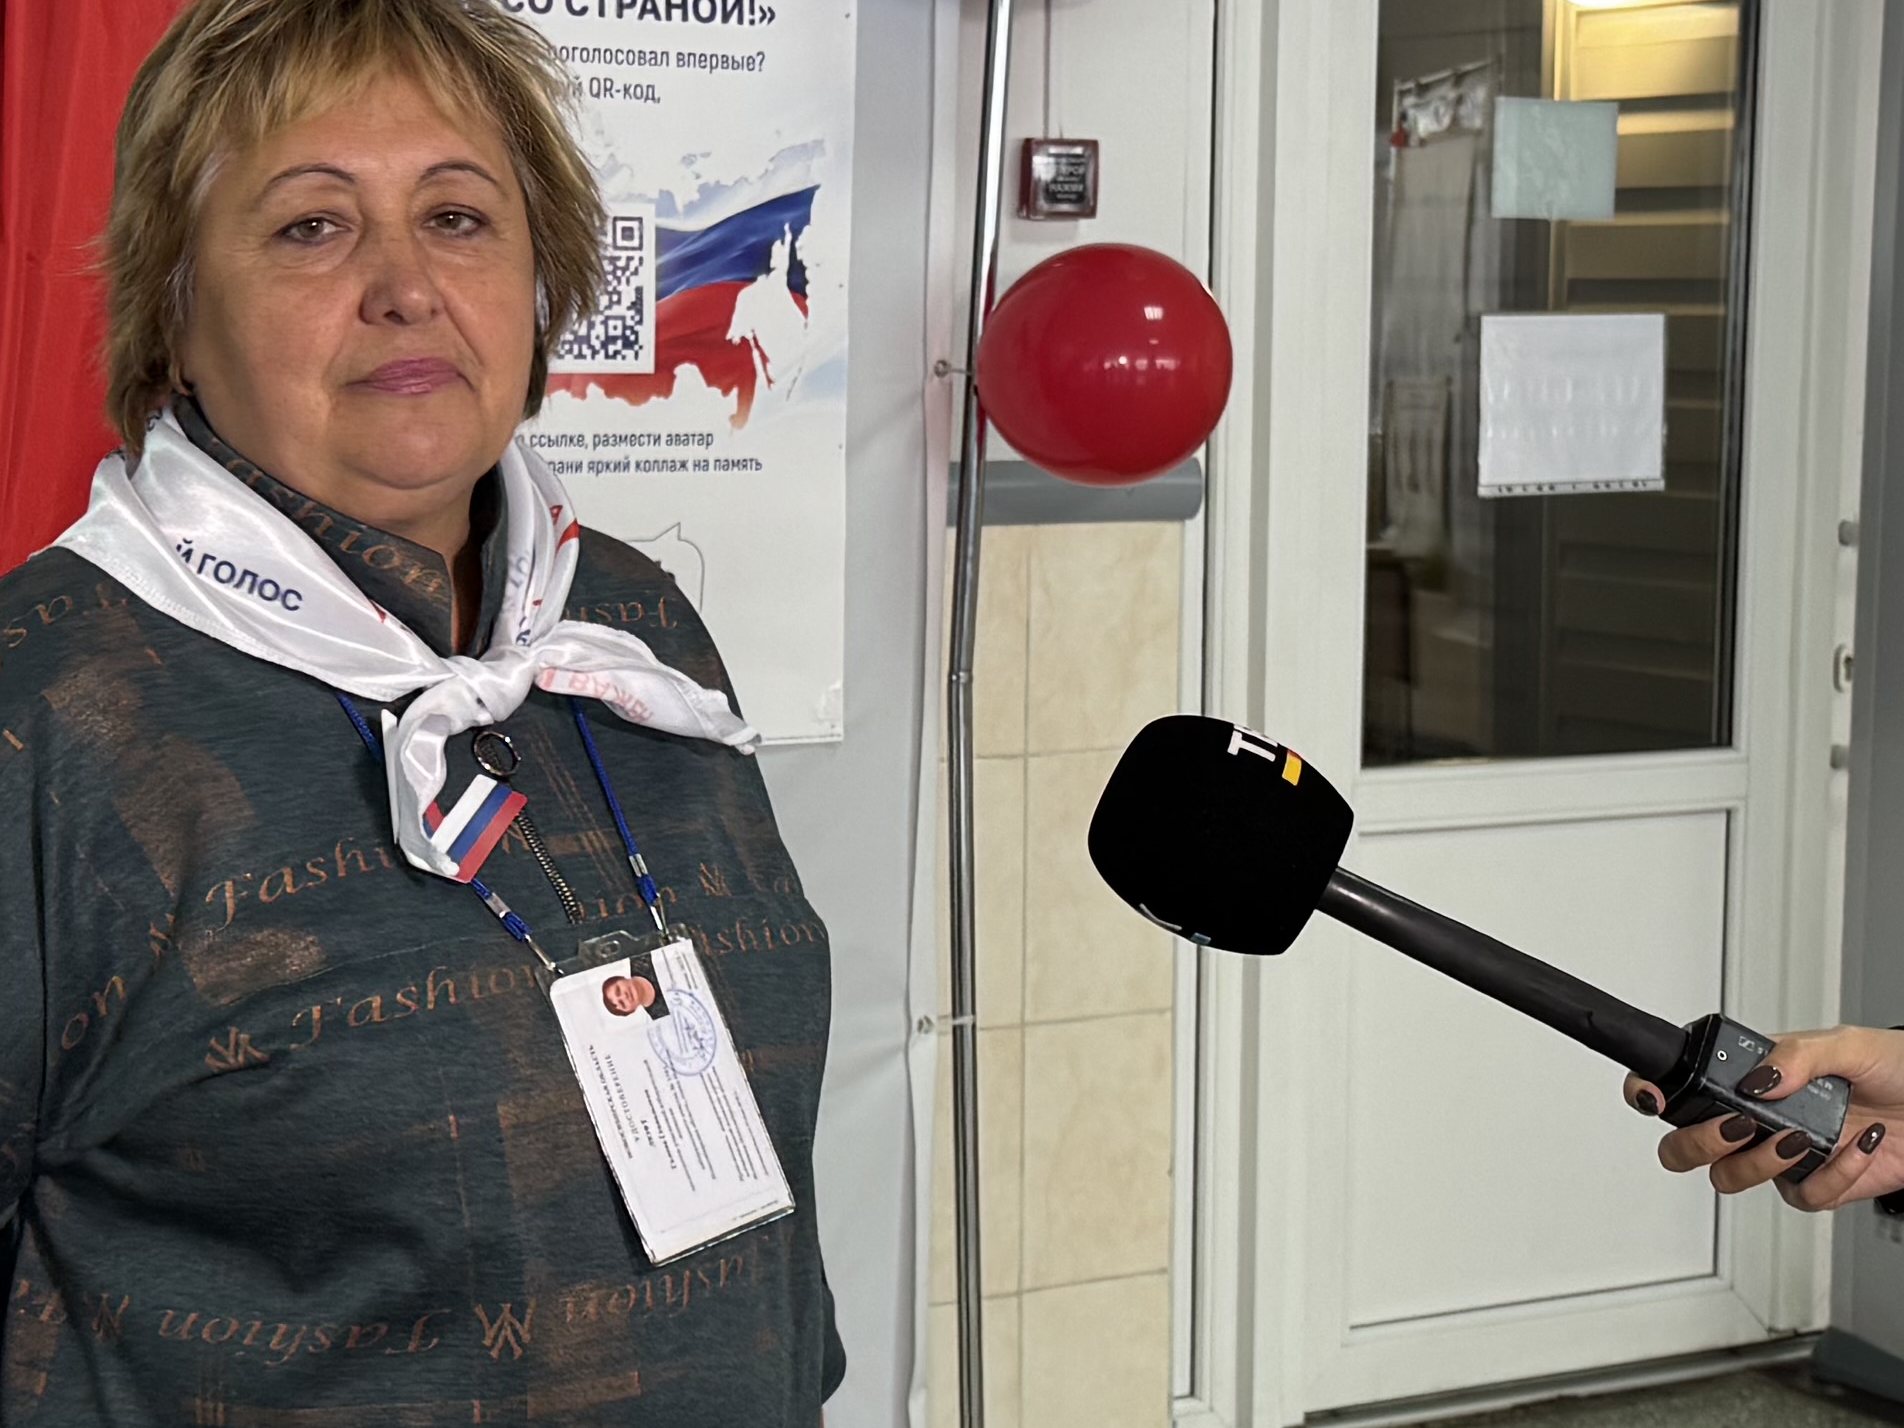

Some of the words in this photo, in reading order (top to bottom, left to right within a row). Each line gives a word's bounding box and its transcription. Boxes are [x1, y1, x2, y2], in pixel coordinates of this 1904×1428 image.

[676, 51, 766, 74] впервые?
[589, 76, 661, 104] QR-код,
[530, 432, 588, 449] ссылке,
[592, 432, 661, 451] размести
[665, 432, 714, 450] аватар
[587, 456, 630, 476] яркий
[635, 458, 688, 473] коллаж
[692, 459, 709, 472] на
[713, 457, 763, 472] память
[196, 553, 303, 611] ГОЛОС
